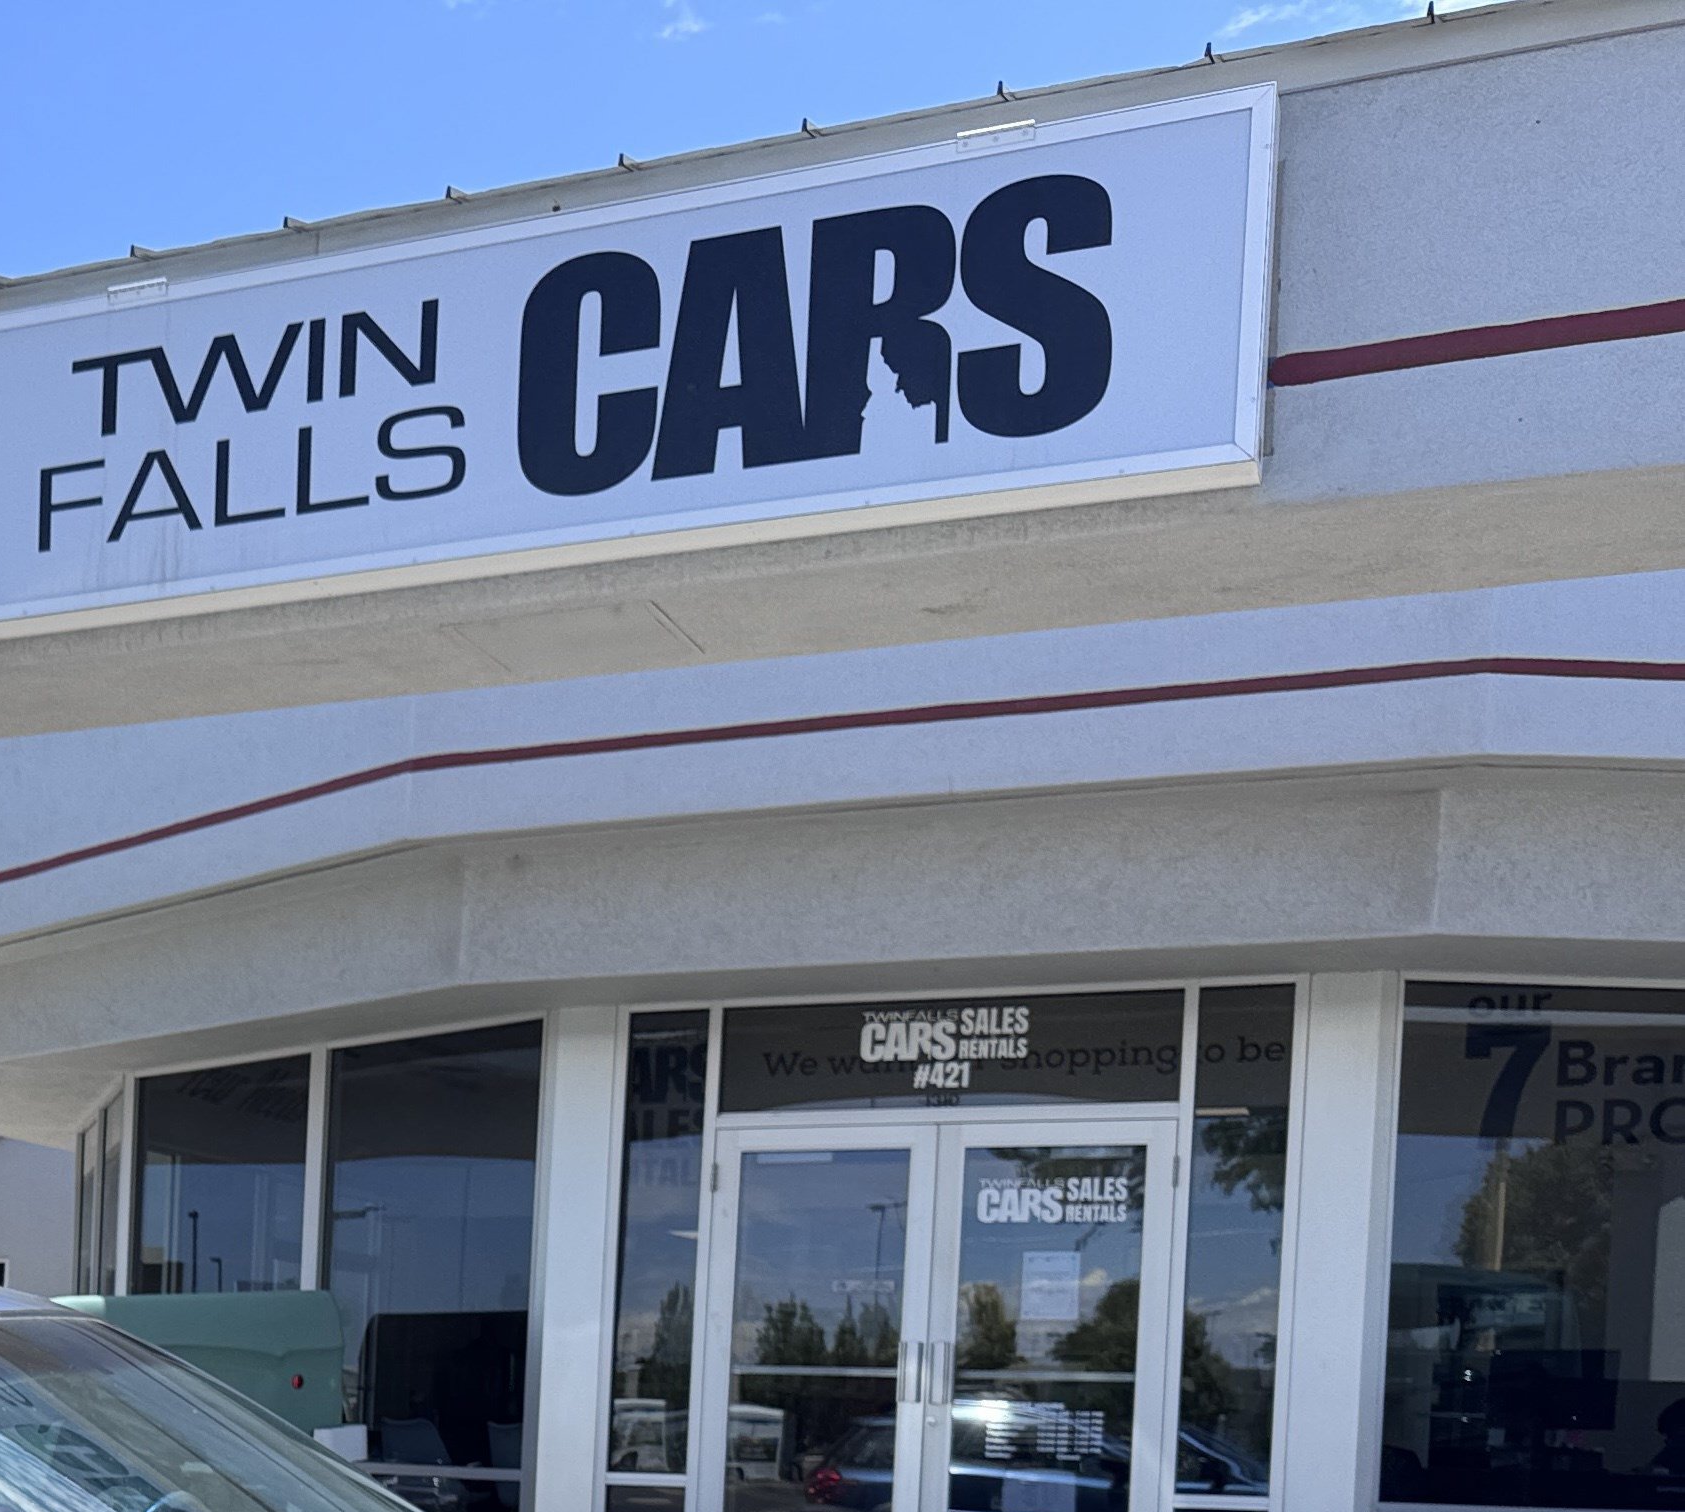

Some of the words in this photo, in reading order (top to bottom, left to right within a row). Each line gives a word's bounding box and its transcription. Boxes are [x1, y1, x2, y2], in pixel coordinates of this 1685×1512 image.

[519, 175, 1111, 494] CARS
[73, 300, 438, 434] TWIN
[40, 407, 465, 550] FALLS
[960, 1006, 1030, 1036] SALES
[1468, 992, 1552, 1018] our
[763, 1050, 818, 1077] We
[1238, 1035, 1286, 1064] be
[860, 1020, 957, 1062] CARS
[959, 1036, 1029, 1060] RENTALS
[914, 1061, 970, 1088] #421
[1465, 1021, 1552, 1151] 7
[977, 1187, 1063, 1223] CARS
[1066, 1176, 1128, 1202] SALES
[1065, 1203, 1127, 1223] RENTALS
